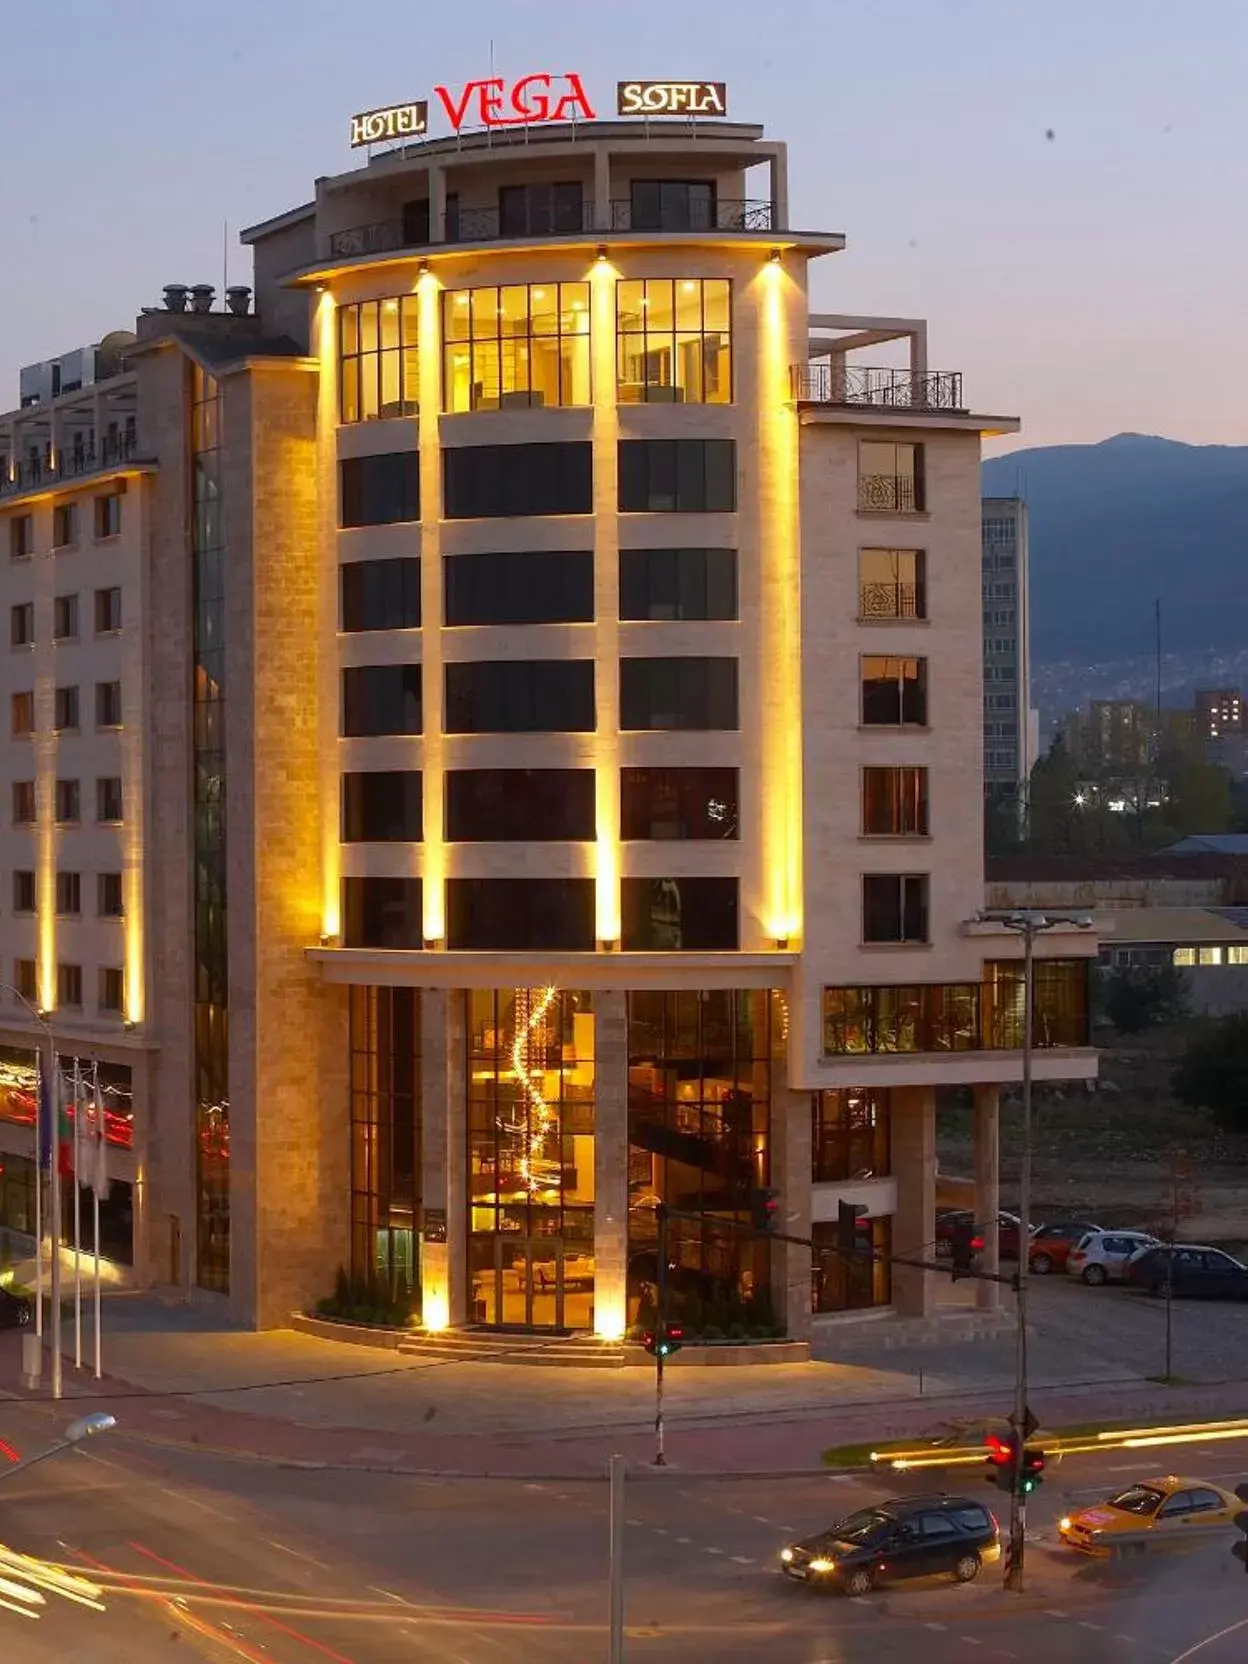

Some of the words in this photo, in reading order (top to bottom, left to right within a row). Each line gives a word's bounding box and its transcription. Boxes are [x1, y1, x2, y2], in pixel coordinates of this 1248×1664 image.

[351, 105, 426, 144] HOTEL
[434, 72, 597, 130] VEGA
[621, 84, 725, 111] SOFIA
